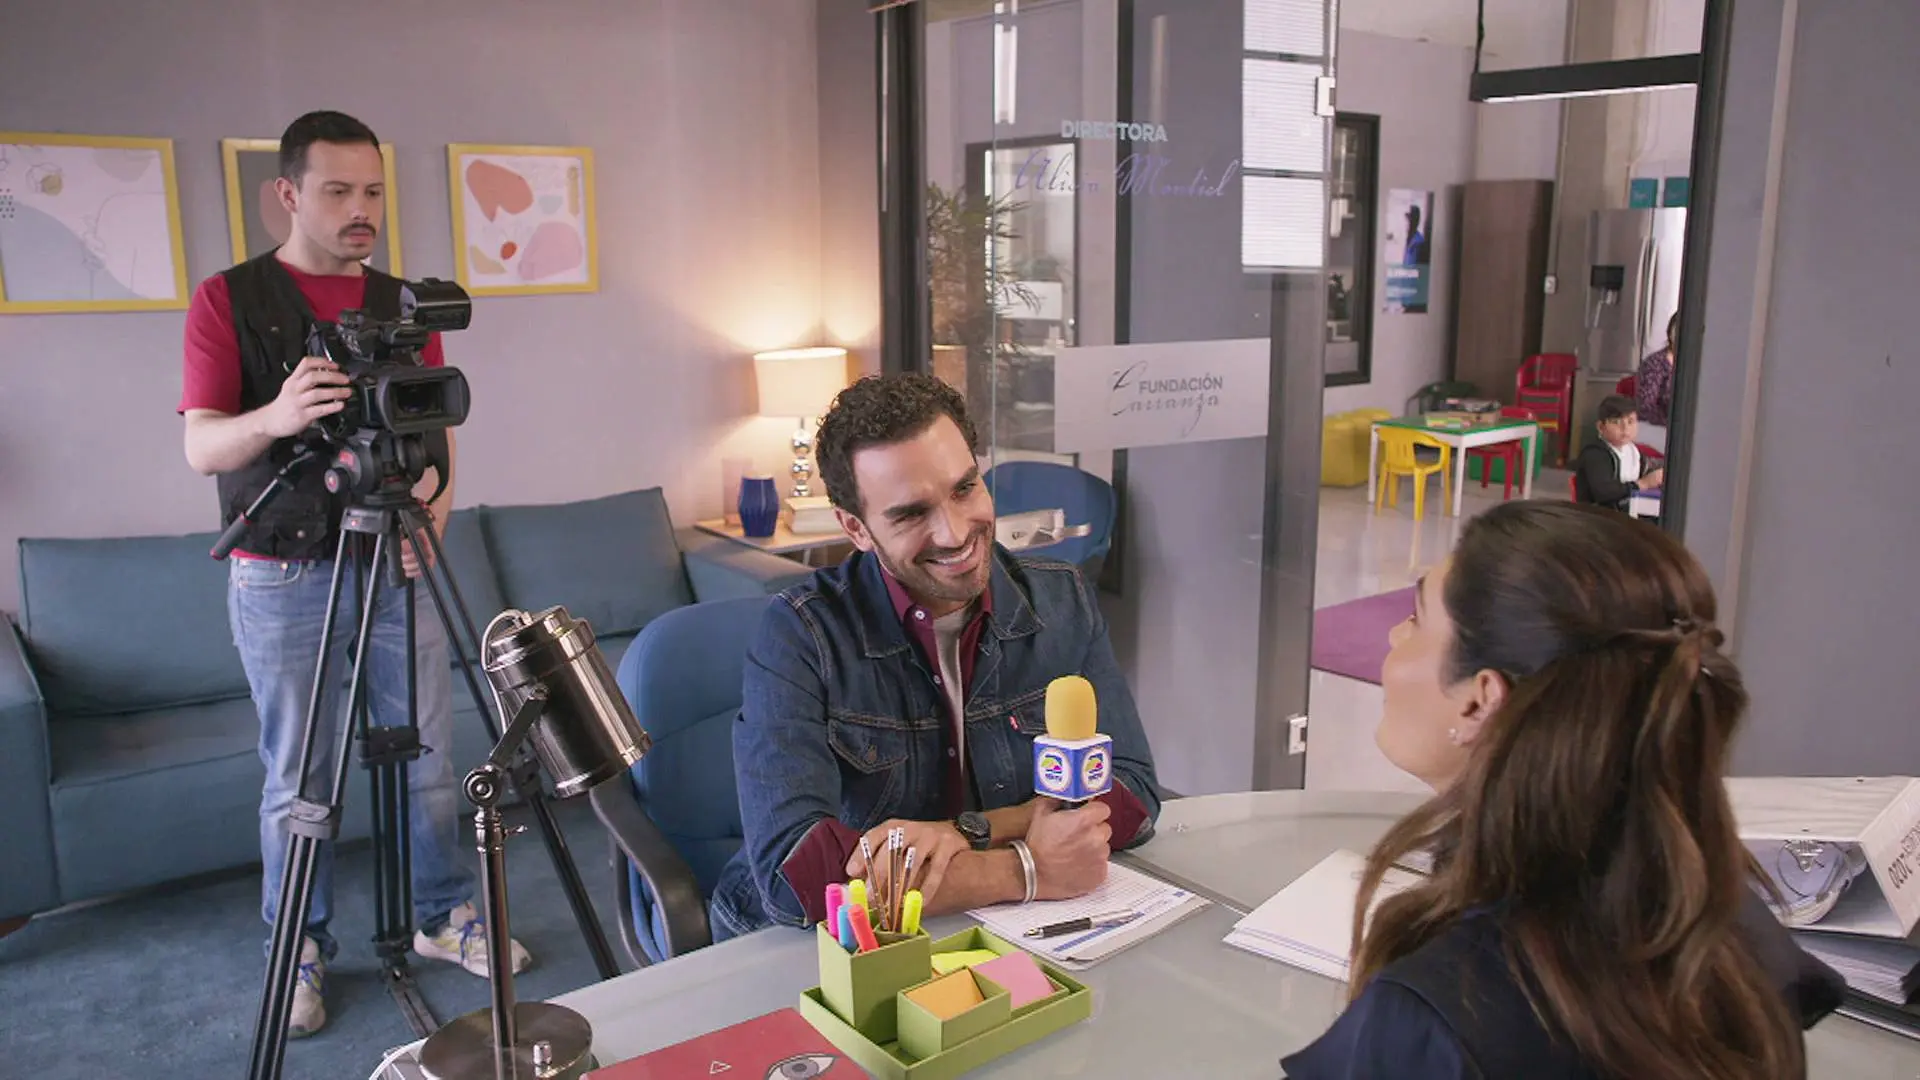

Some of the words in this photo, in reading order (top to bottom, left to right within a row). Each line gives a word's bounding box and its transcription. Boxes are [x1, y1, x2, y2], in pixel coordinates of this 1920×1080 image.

[1061, 119, 1168, 142] DIRECTORA
[1114, 152, 1241, 197] Montiel
[1138, 372, 1224, 394] FUNDACIÓN
